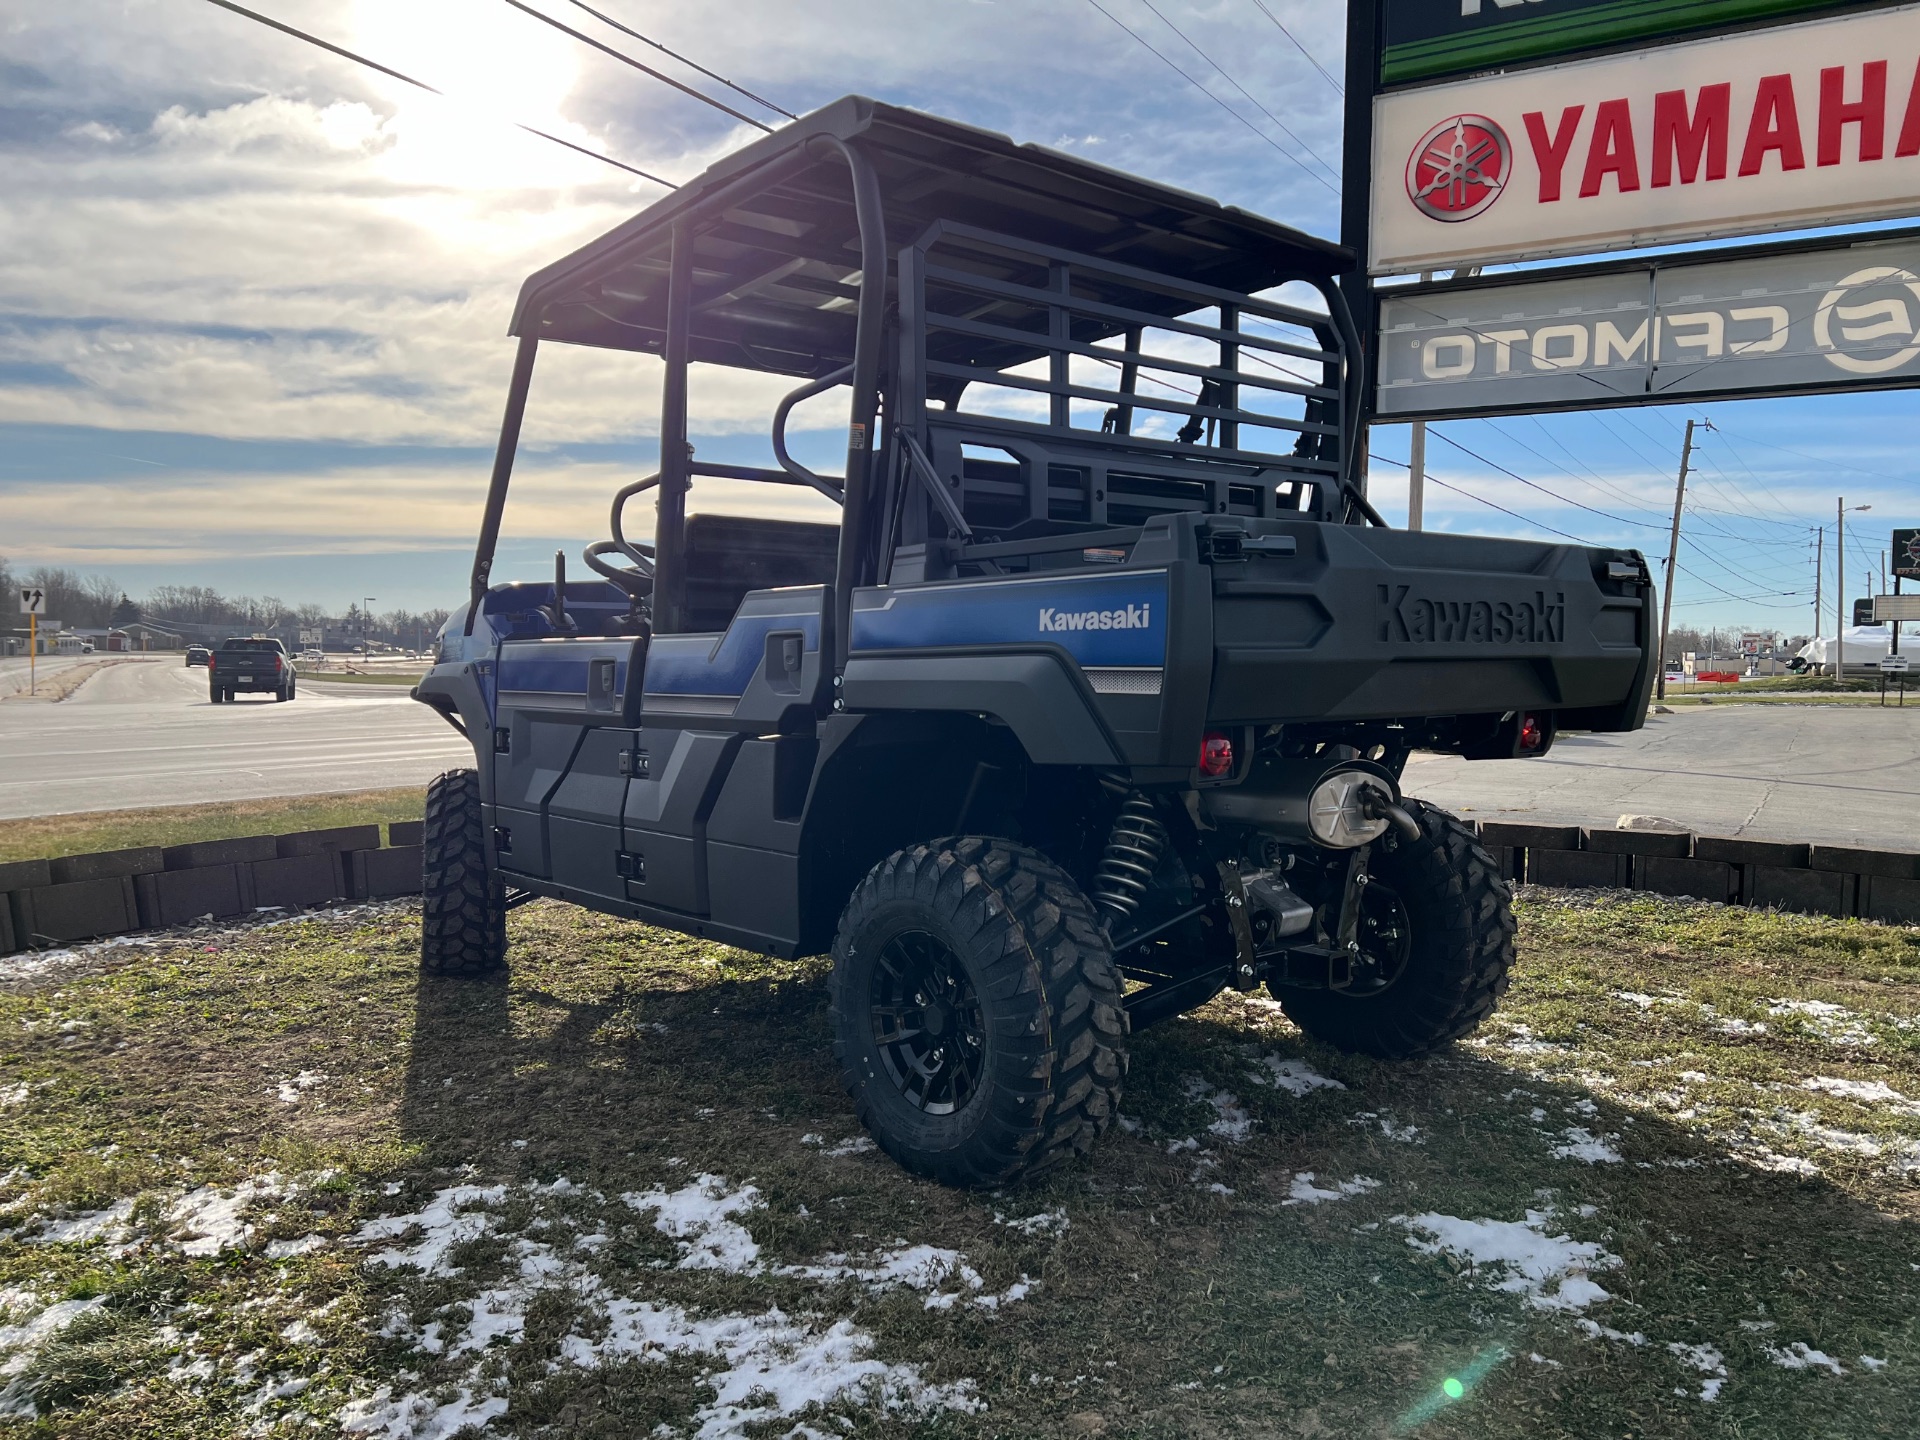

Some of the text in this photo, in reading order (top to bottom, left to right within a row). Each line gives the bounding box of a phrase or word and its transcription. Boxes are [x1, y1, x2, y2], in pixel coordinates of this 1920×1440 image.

[1038, 603, 1150, 632] Kawasaki
[1376, 583, 1566, 643] Kawasaki
[477, 666, 491, 674] LE
